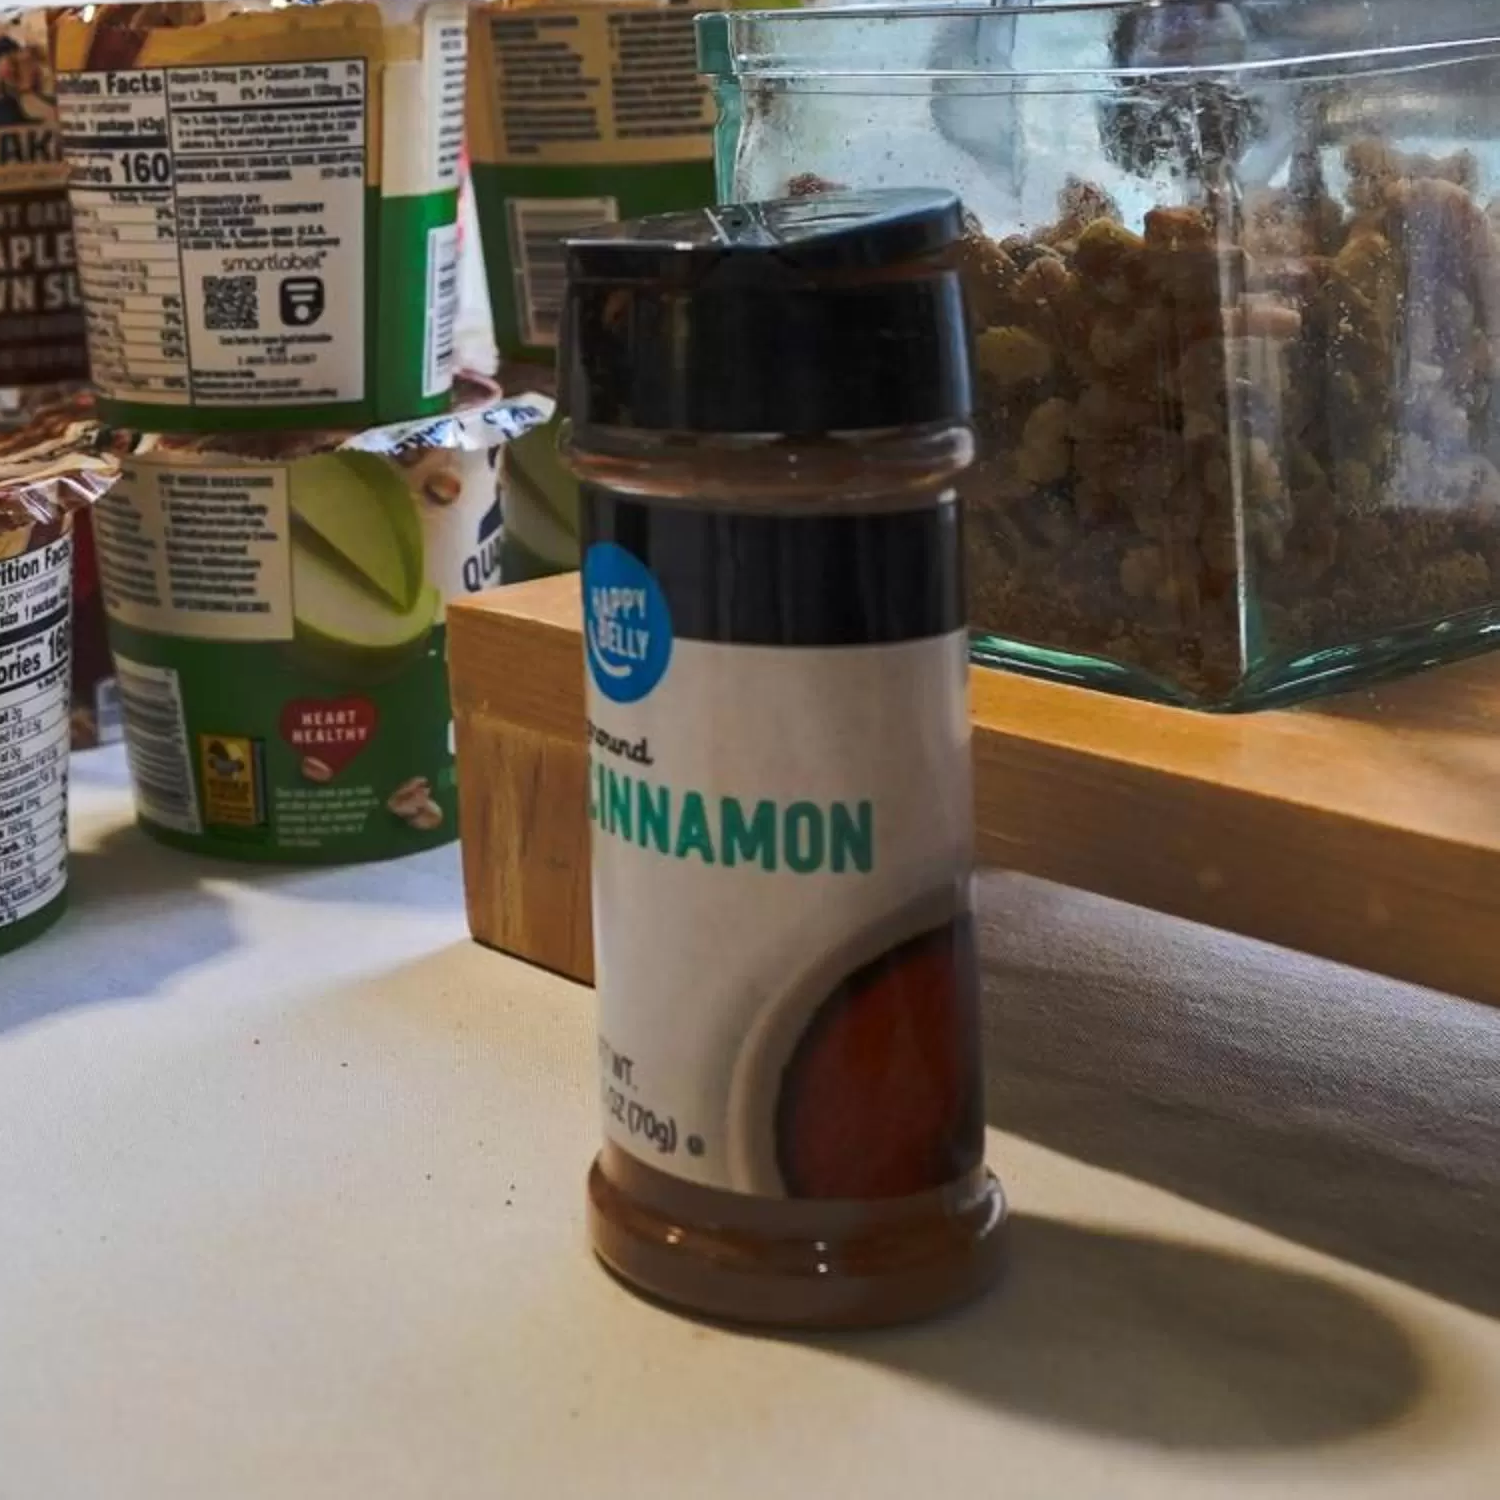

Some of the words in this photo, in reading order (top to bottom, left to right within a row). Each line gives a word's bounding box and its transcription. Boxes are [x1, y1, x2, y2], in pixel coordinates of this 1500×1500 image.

[106, 72, 163, 95] Facts
[120, 152, 169, 183] 160
[221, 252, 323, 273] smartlabel
[591, 586, 648, 620] HAPPY
[597, 618, 650, 661] BELLY
[301, 710, 357, 726] HEART
[291, 727, 368, 744] HEALTHY
[590, 762, 873, 875] INNAMON
[627, 1099, 678, 1156] (70g)
